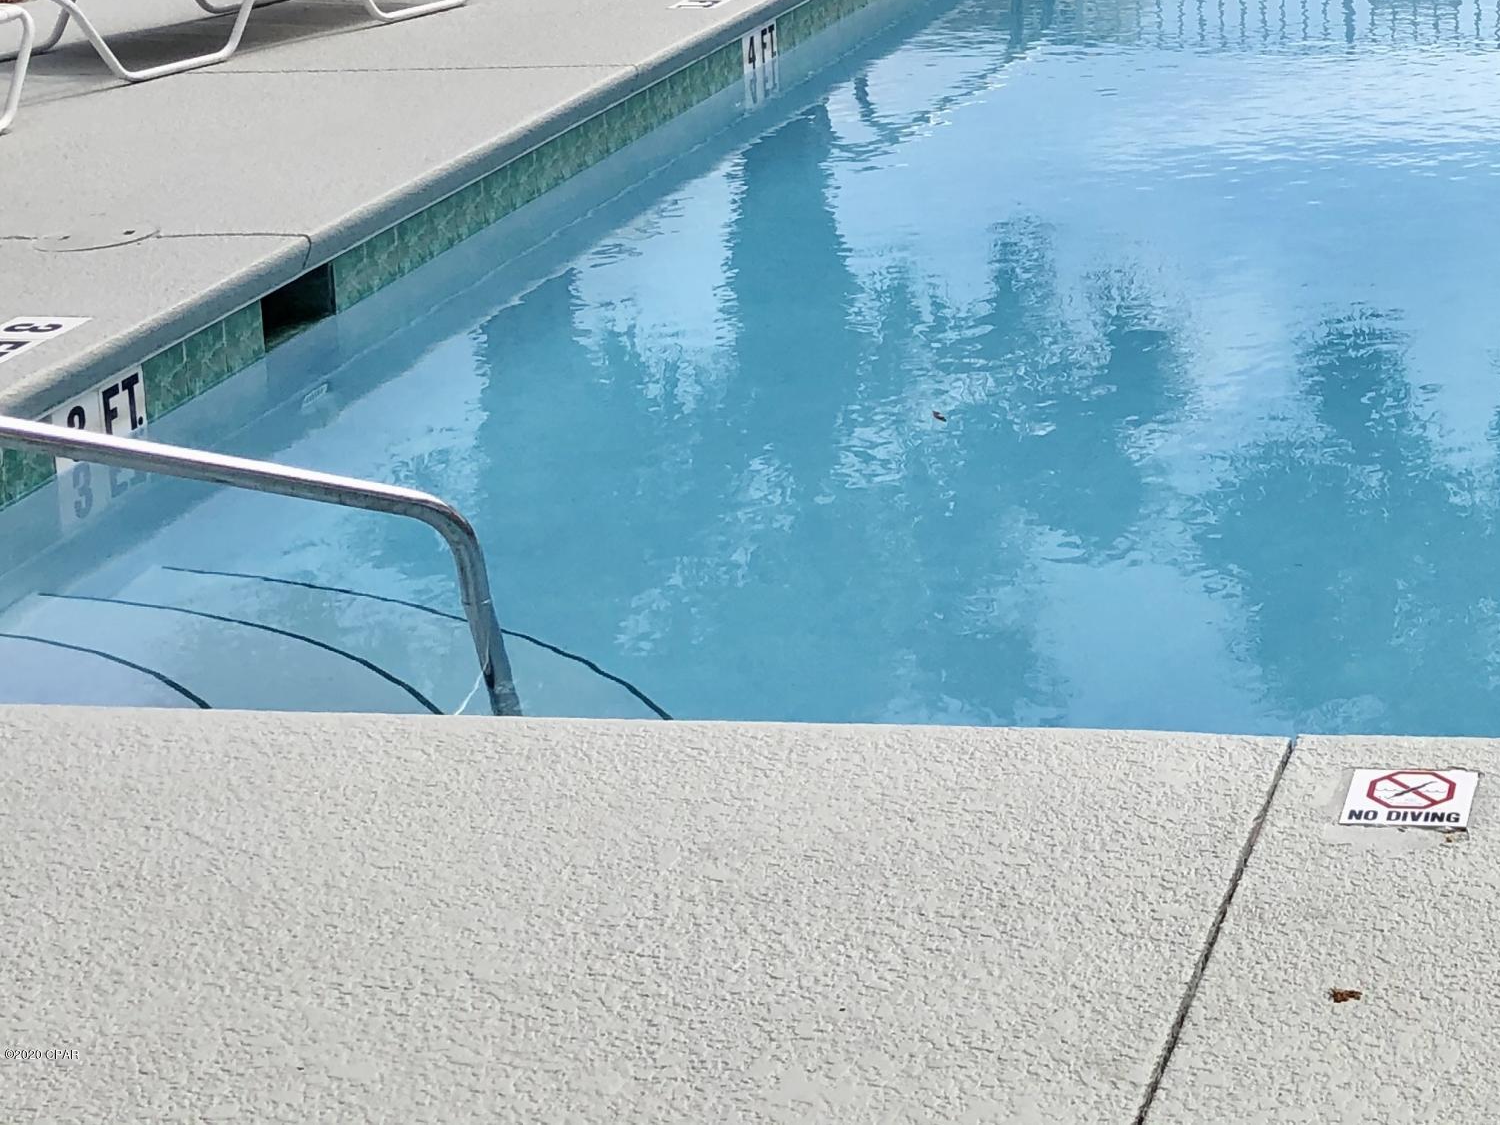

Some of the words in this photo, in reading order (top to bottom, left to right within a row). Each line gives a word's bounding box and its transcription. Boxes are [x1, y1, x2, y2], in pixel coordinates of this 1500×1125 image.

[748, 35, 756, 69] 4
[1347, 809, 1379, 821] NO
[1386, 810, 1462, 823] DIVING
